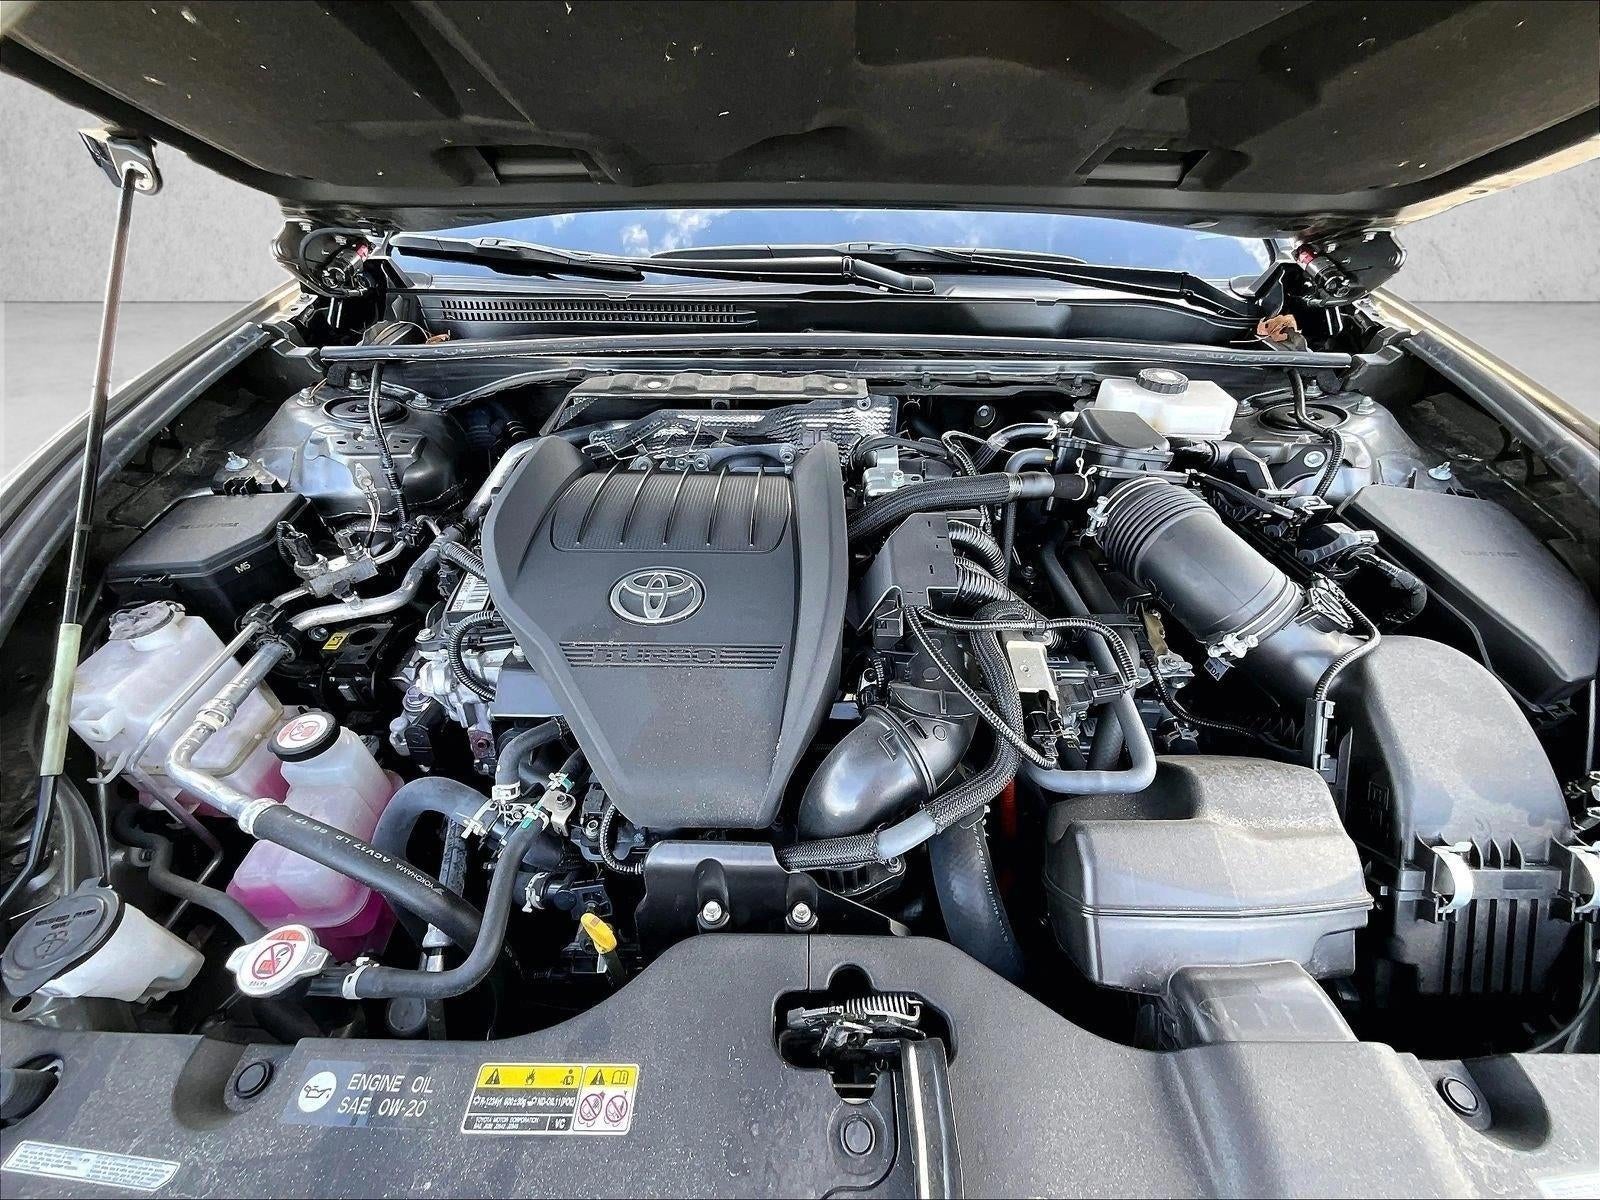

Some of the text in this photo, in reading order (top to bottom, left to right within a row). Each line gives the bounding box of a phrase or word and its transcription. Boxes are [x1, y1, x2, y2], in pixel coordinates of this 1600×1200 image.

[396, 863, 434, 890] YOKOHAMA
[347, 1073, 434, 1094] ENGINE OIL
[337, 1096, 428, 1117] SAE 0W-20
